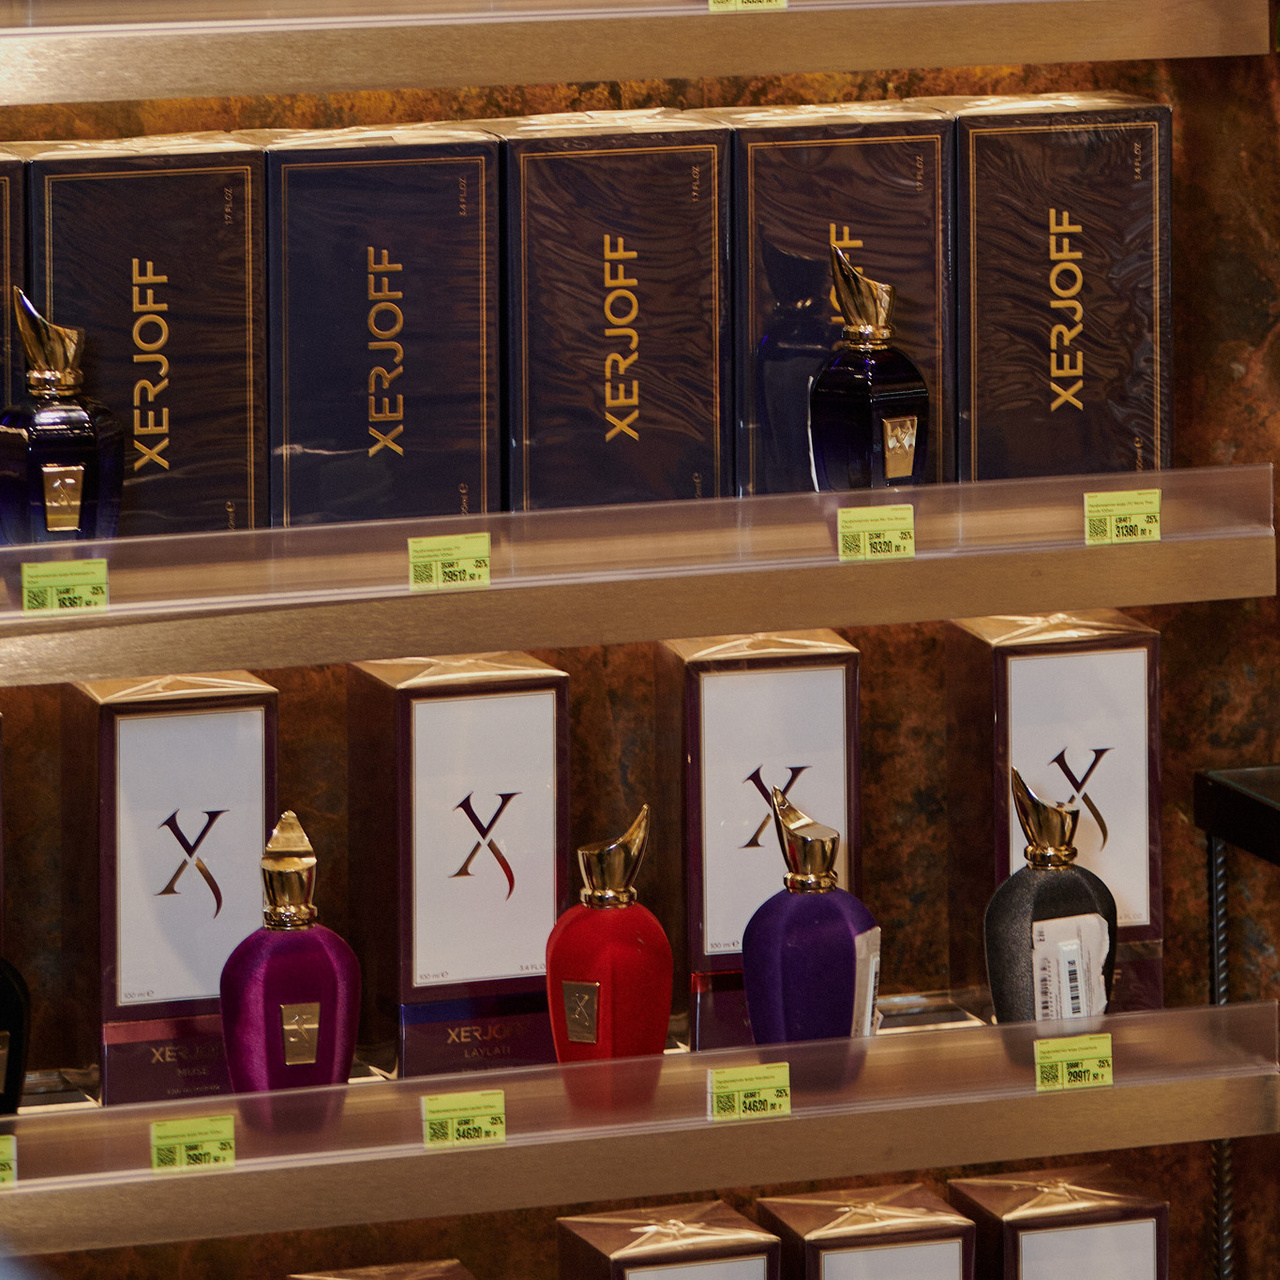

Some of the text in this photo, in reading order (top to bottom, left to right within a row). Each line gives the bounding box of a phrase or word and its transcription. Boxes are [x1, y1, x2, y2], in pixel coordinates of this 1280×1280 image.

[132, 257, 170, 471] XERJOFF
[367, 246, 404, 458] XERJOFF
[604, 234, 641, 443] XERJOFF
[1049, 207, 1084, 412] XERJOFF
[1115, 524, 1139, 538] 31380
[154, 807, 230, 920] X
[447, 790, 523, 902] X
